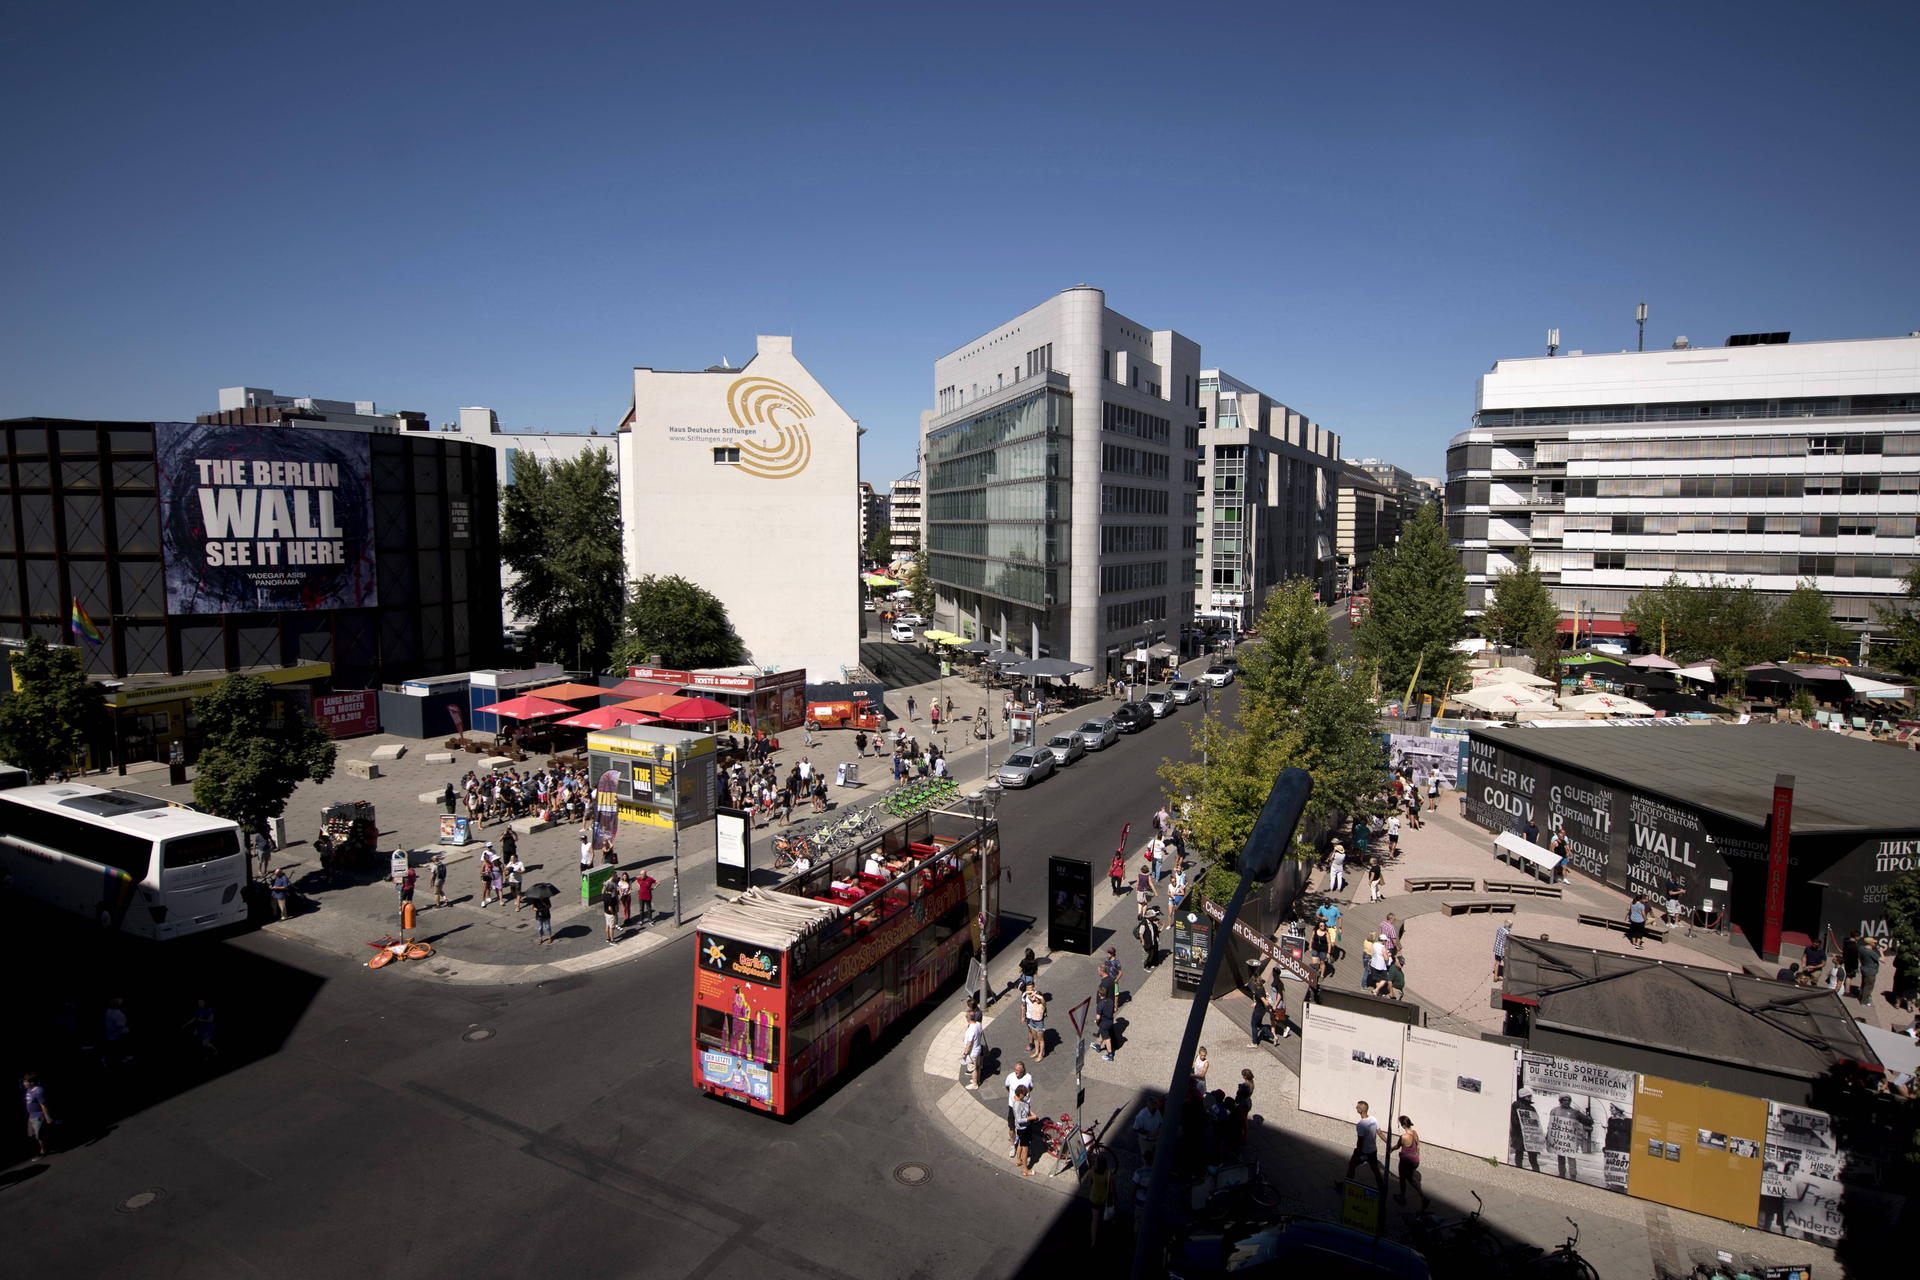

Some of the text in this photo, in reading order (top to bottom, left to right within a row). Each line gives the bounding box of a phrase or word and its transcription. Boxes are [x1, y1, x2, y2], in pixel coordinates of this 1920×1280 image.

[669, 435, 733, 443] www.Stiftungen.org
[195, 459, 339, 487] THE BERLIN
[198, 488, 343, 538] WALL
[205, 541, 345, 566] SEE IT HERE
[1470, 740, 1496, 759] МИР
[633, 767, 651, 782] THE
[633, 780, 652, 792] WALL
[1484, 786, 1523, 817] COLD
[1563, 785, 1609, 812] GUERRE
[635, 807, 651, 818] HERE
[1555, 804, 1594, 827] CURTAIN
[1634, 823, 1697, 869] WALL
[1706, 834, 1769, 852] EXHIBITION
[1628, 843, 1669, 869] WEAPON
[740, 953, 764, 970] Berlin
[1243, 926, 1271, 953] Charlie
[1272, 946, 1311, 981] BlackBox
[1529, 1066, 1540, 1075] DU
[1544, 1070, 1578, 1081] SECTEUR
[1574, 1065, 1609, 1079] SORTEZ
[1550, 1130, 1576, 1142] Ulrike
[1766, 1185, 1788, 1196] KALK
